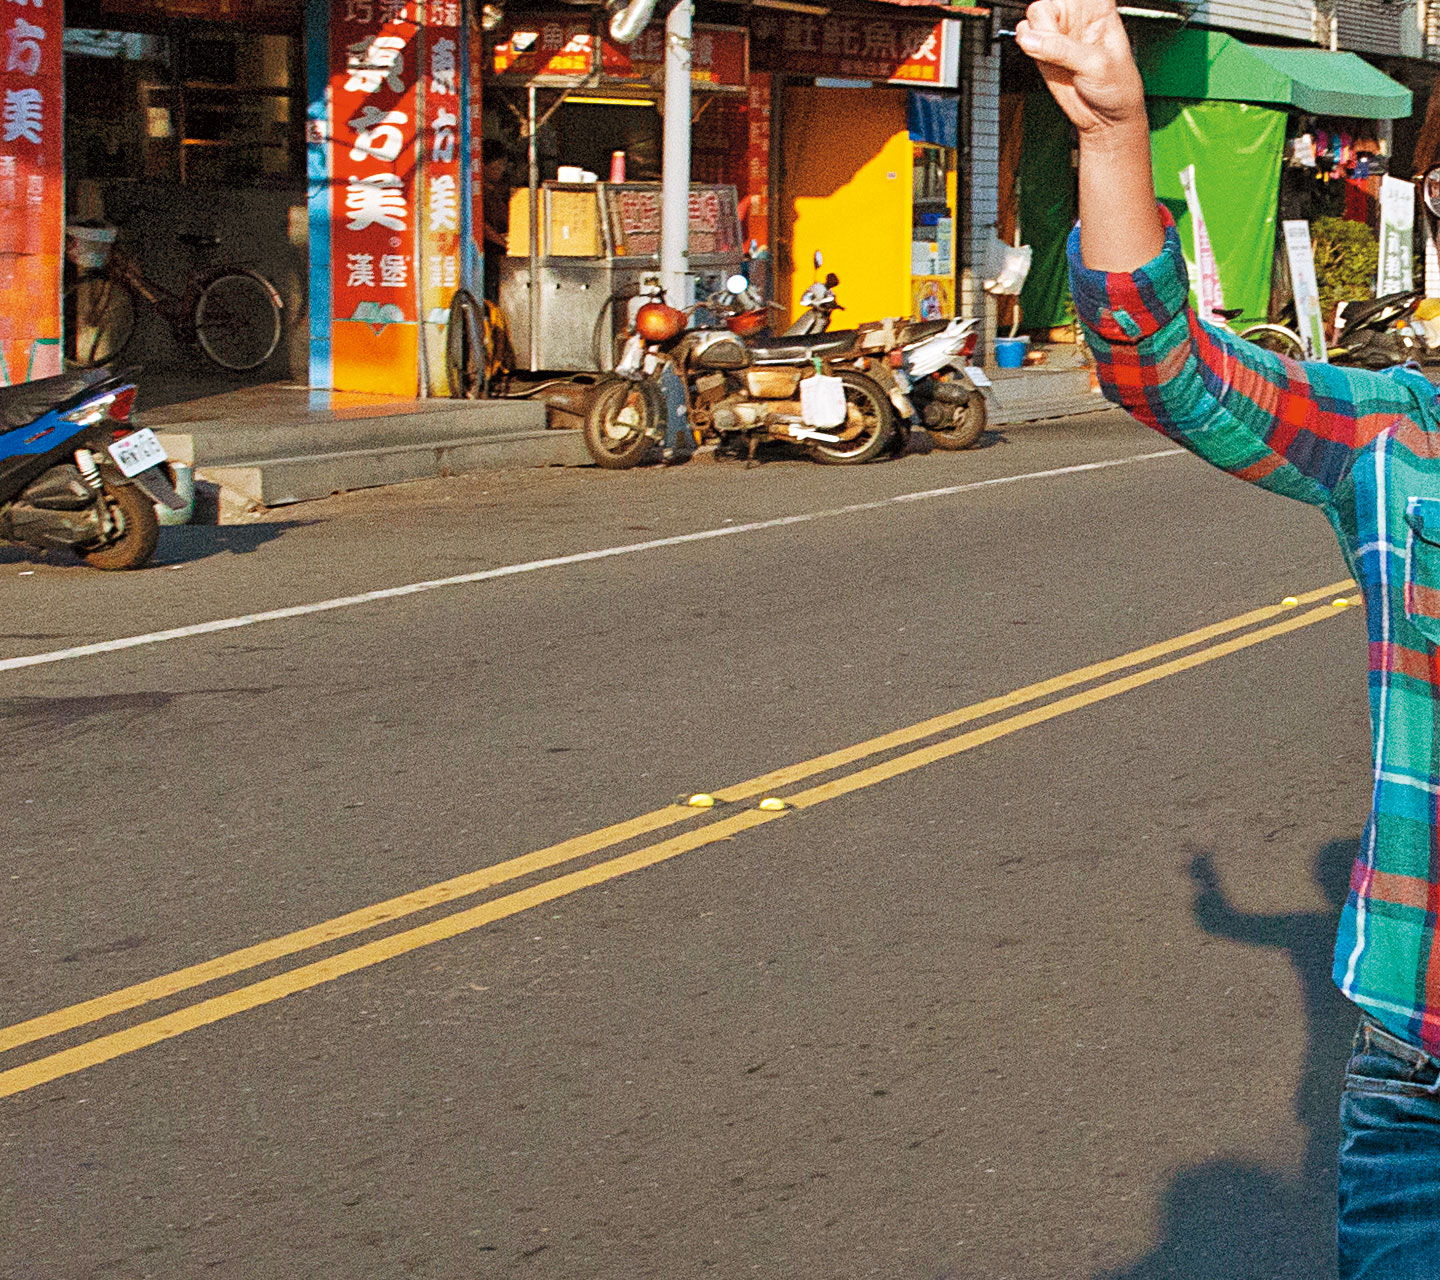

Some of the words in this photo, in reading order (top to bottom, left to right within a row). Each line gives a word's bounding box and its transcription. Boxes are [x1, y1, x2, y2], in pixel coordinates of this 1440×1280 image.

[345, 35, 408, 232] 東方美
[346, 253, 409, 289] 漢堡
